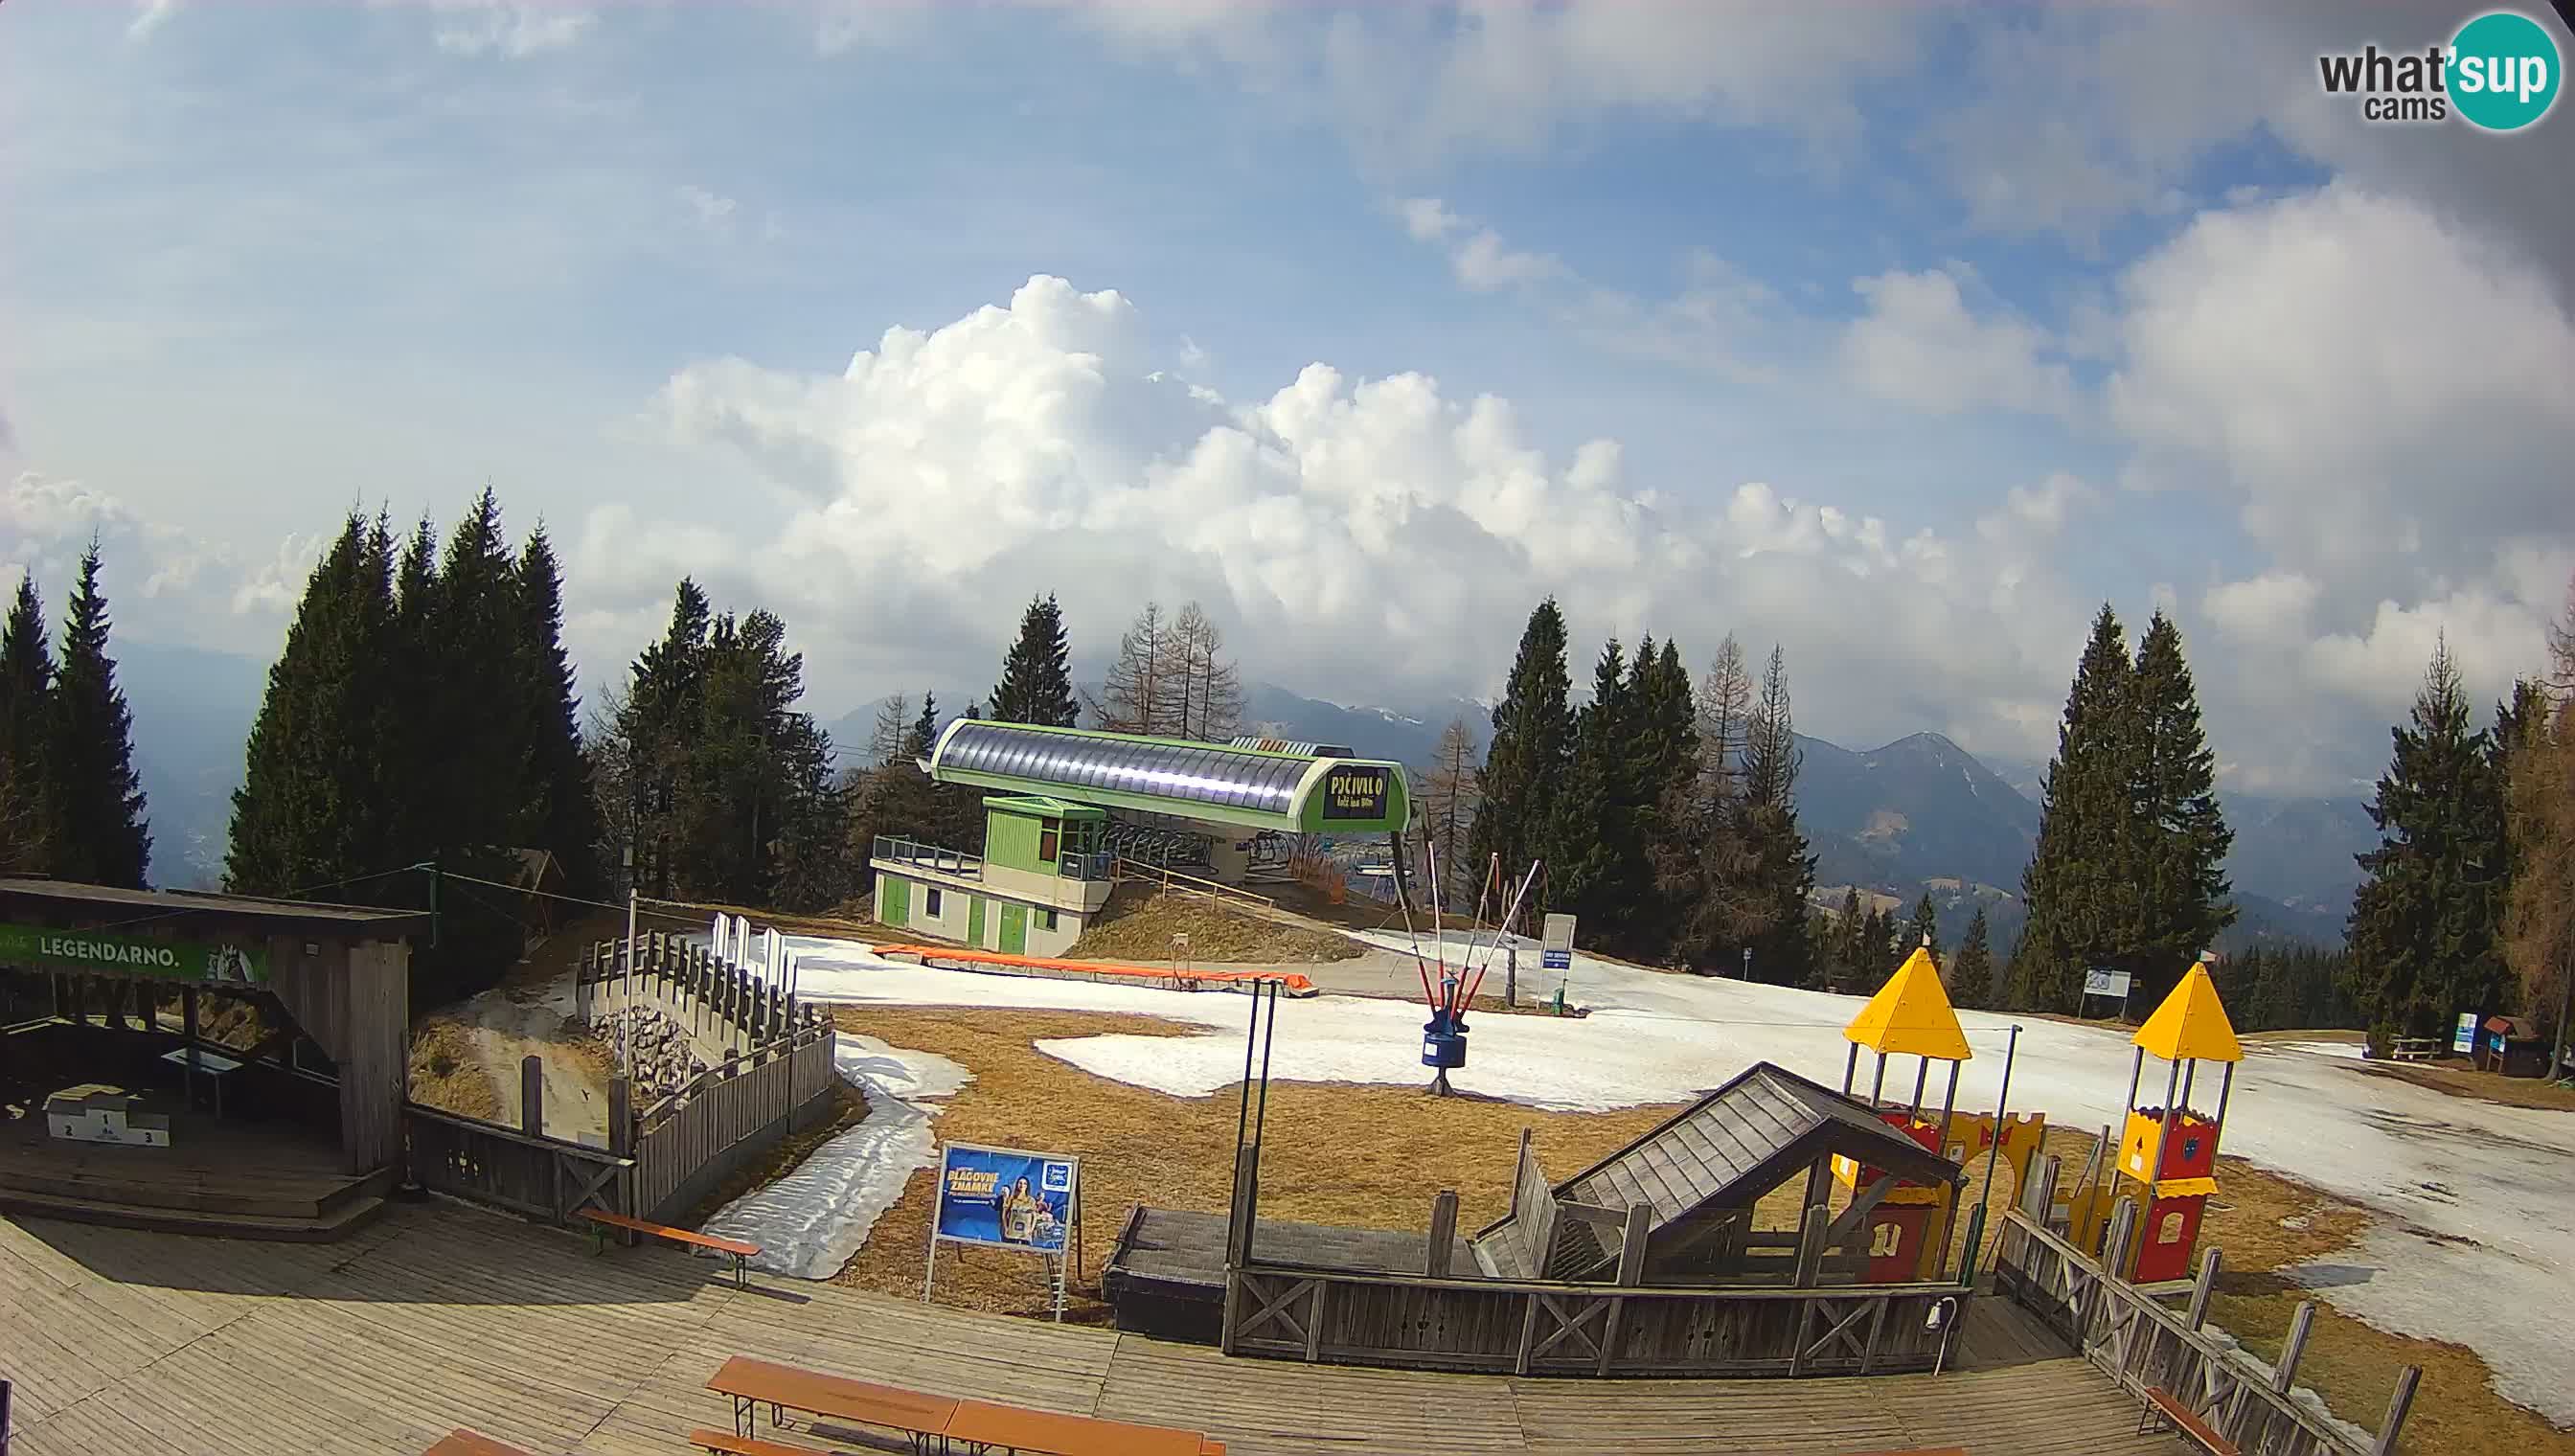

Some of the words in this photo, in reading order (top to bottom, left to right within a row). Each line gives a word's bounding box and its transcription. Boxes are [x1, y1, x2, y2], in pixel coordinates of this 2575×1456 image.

[39, 937, 181, 968] LEGENDARNO.
[103, 1114, 109, 1125] 1
[64, 1125, 73, 1136] 2
[145, 1132, 153, 1143] 3
